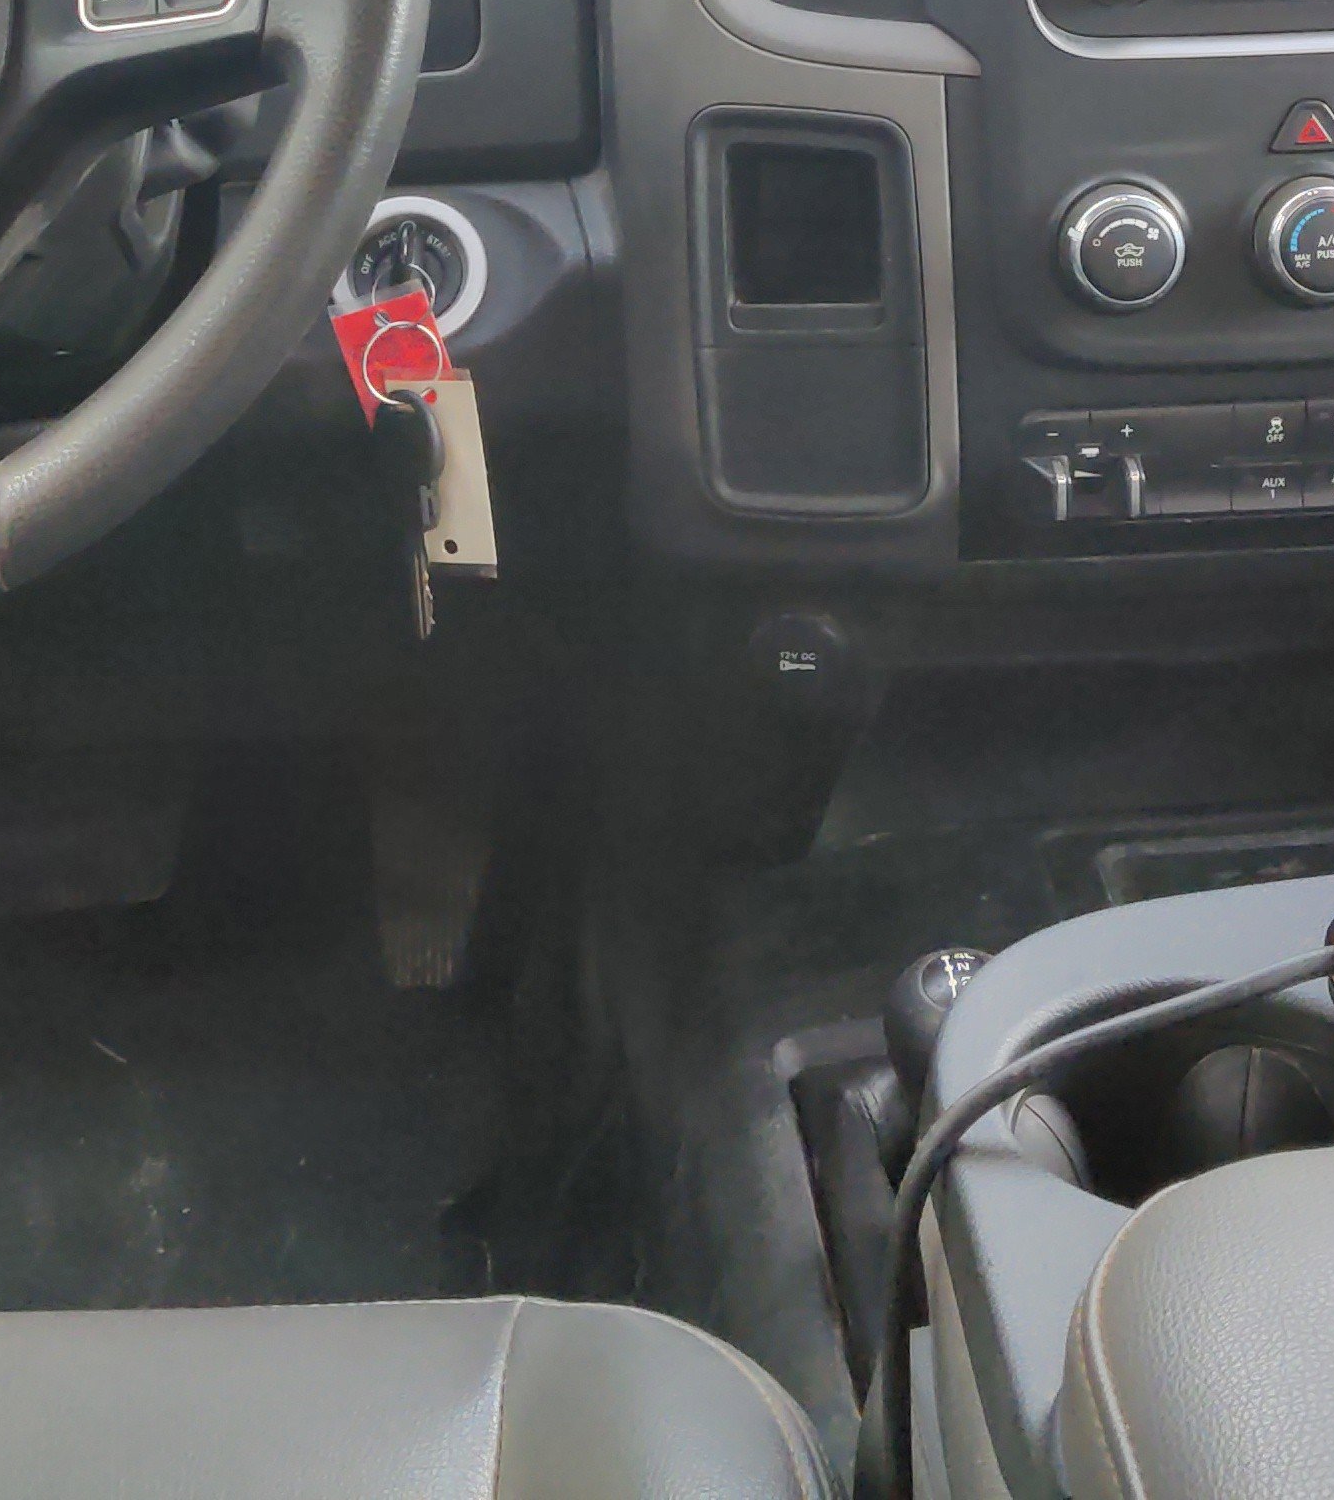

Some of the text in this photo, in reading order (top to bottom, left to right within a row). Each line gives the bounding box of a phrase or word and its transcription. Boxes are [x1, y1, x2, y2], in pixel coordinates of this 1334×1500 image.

[1117, 258, 1143, 268] PUSH
[1265, 433, 1285, 443] OFF
[1262, 477, 1286, 488] AUX
